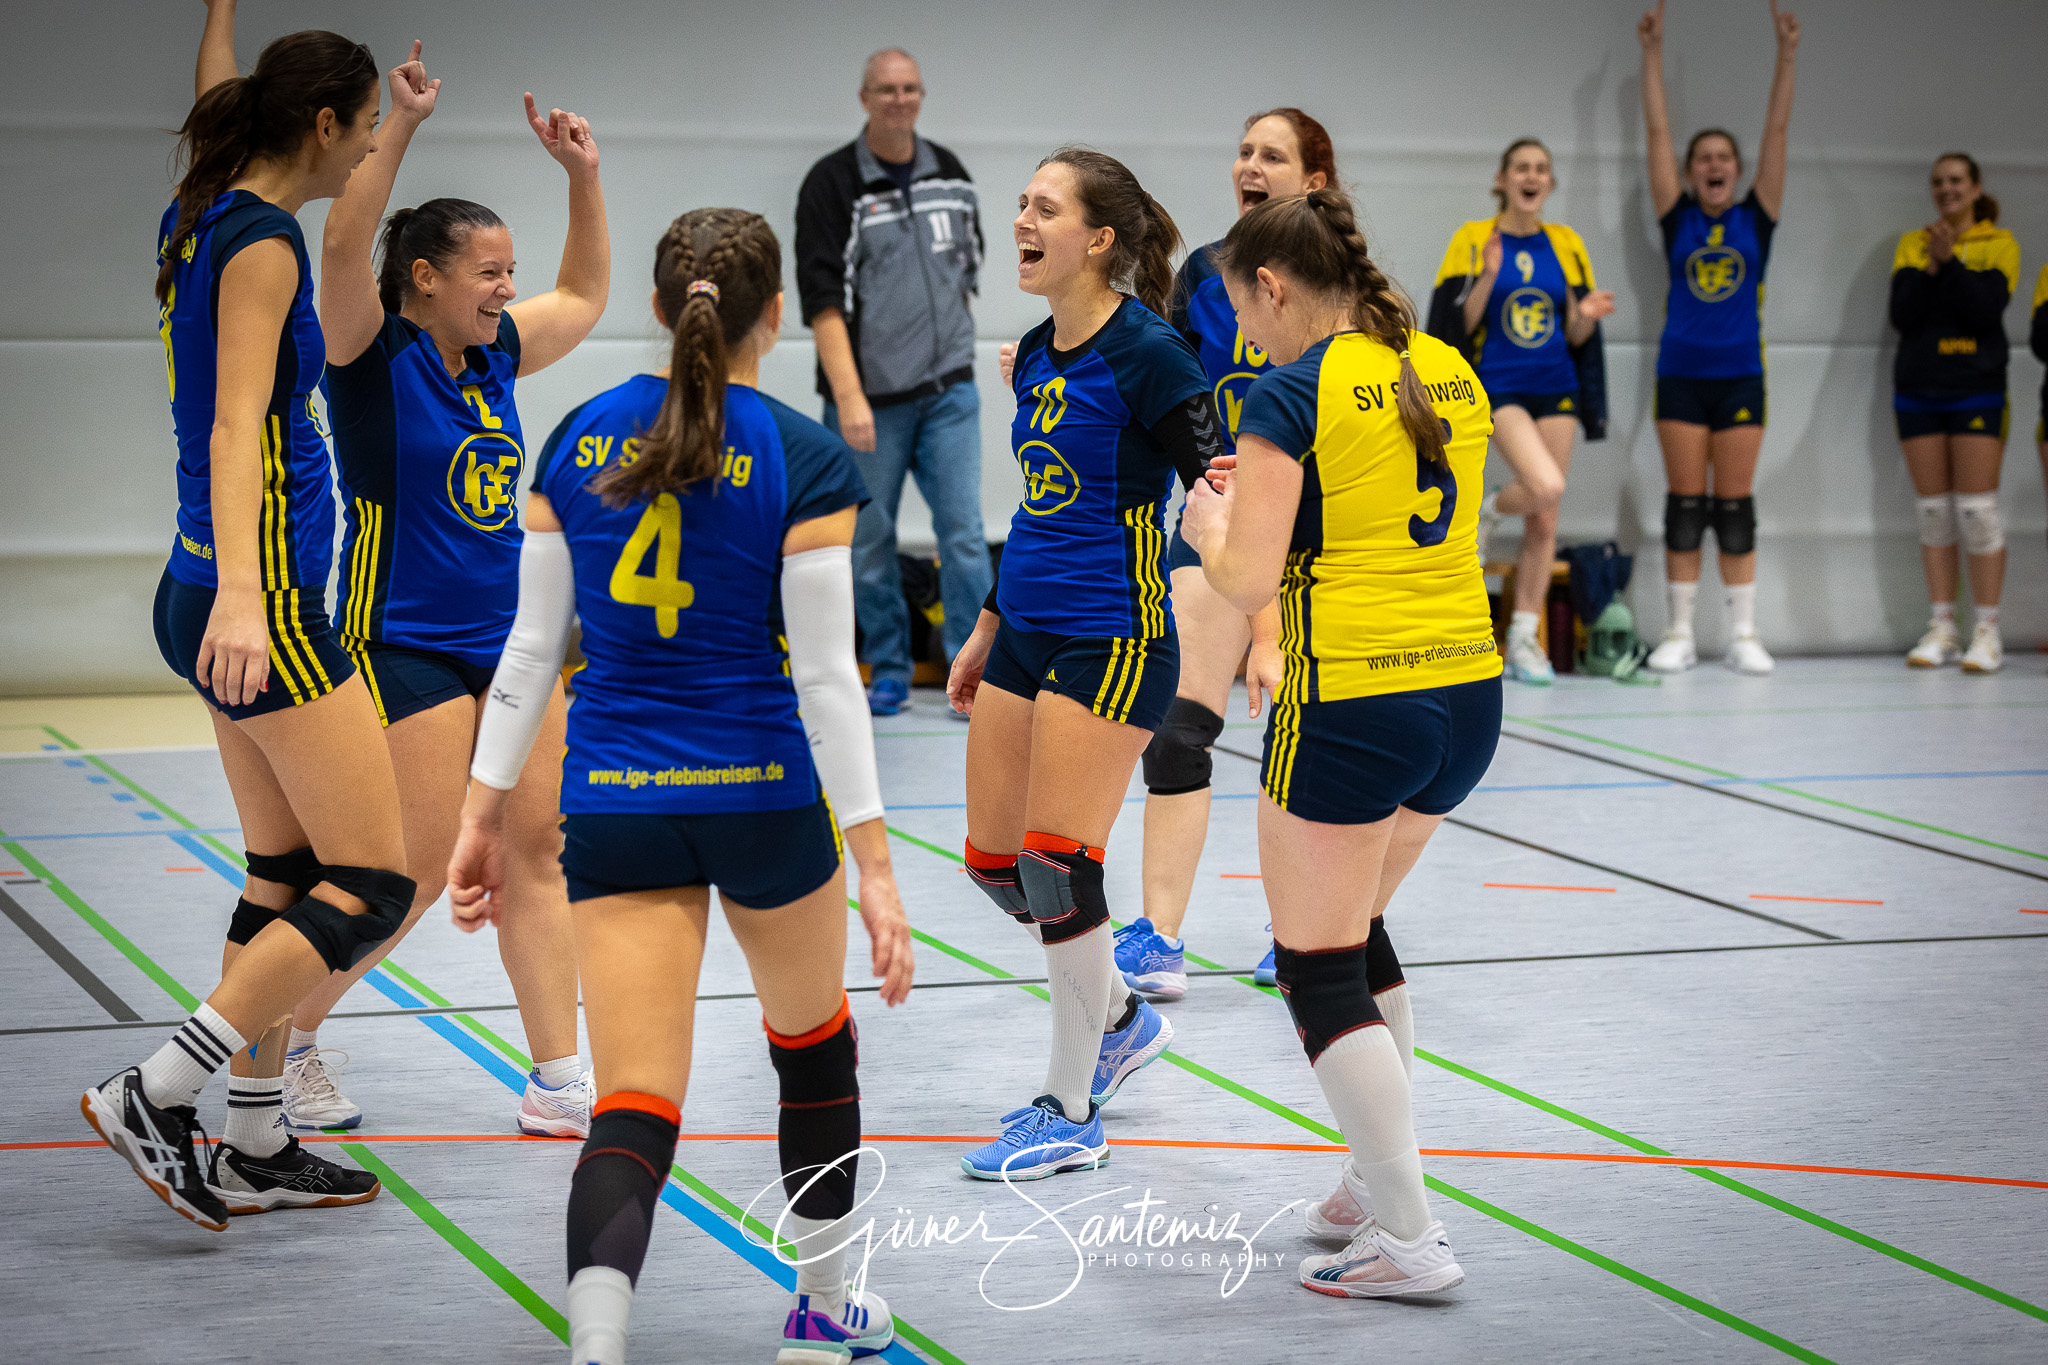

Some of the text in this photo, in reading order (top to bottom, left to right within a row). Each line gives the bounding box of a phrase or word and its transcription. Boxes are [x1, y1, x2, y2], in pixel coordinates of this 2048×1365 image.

[1514, 250, 1534, 283] 9
[1029, 376, 1068, 433] 10
[1353, 384, 1384, 411] SV
[575, 436, 614, 467] SV
[609, 492, 695, 638] 4
[588, 761, 784, 789] www.ige-erlebnisreisen.de
